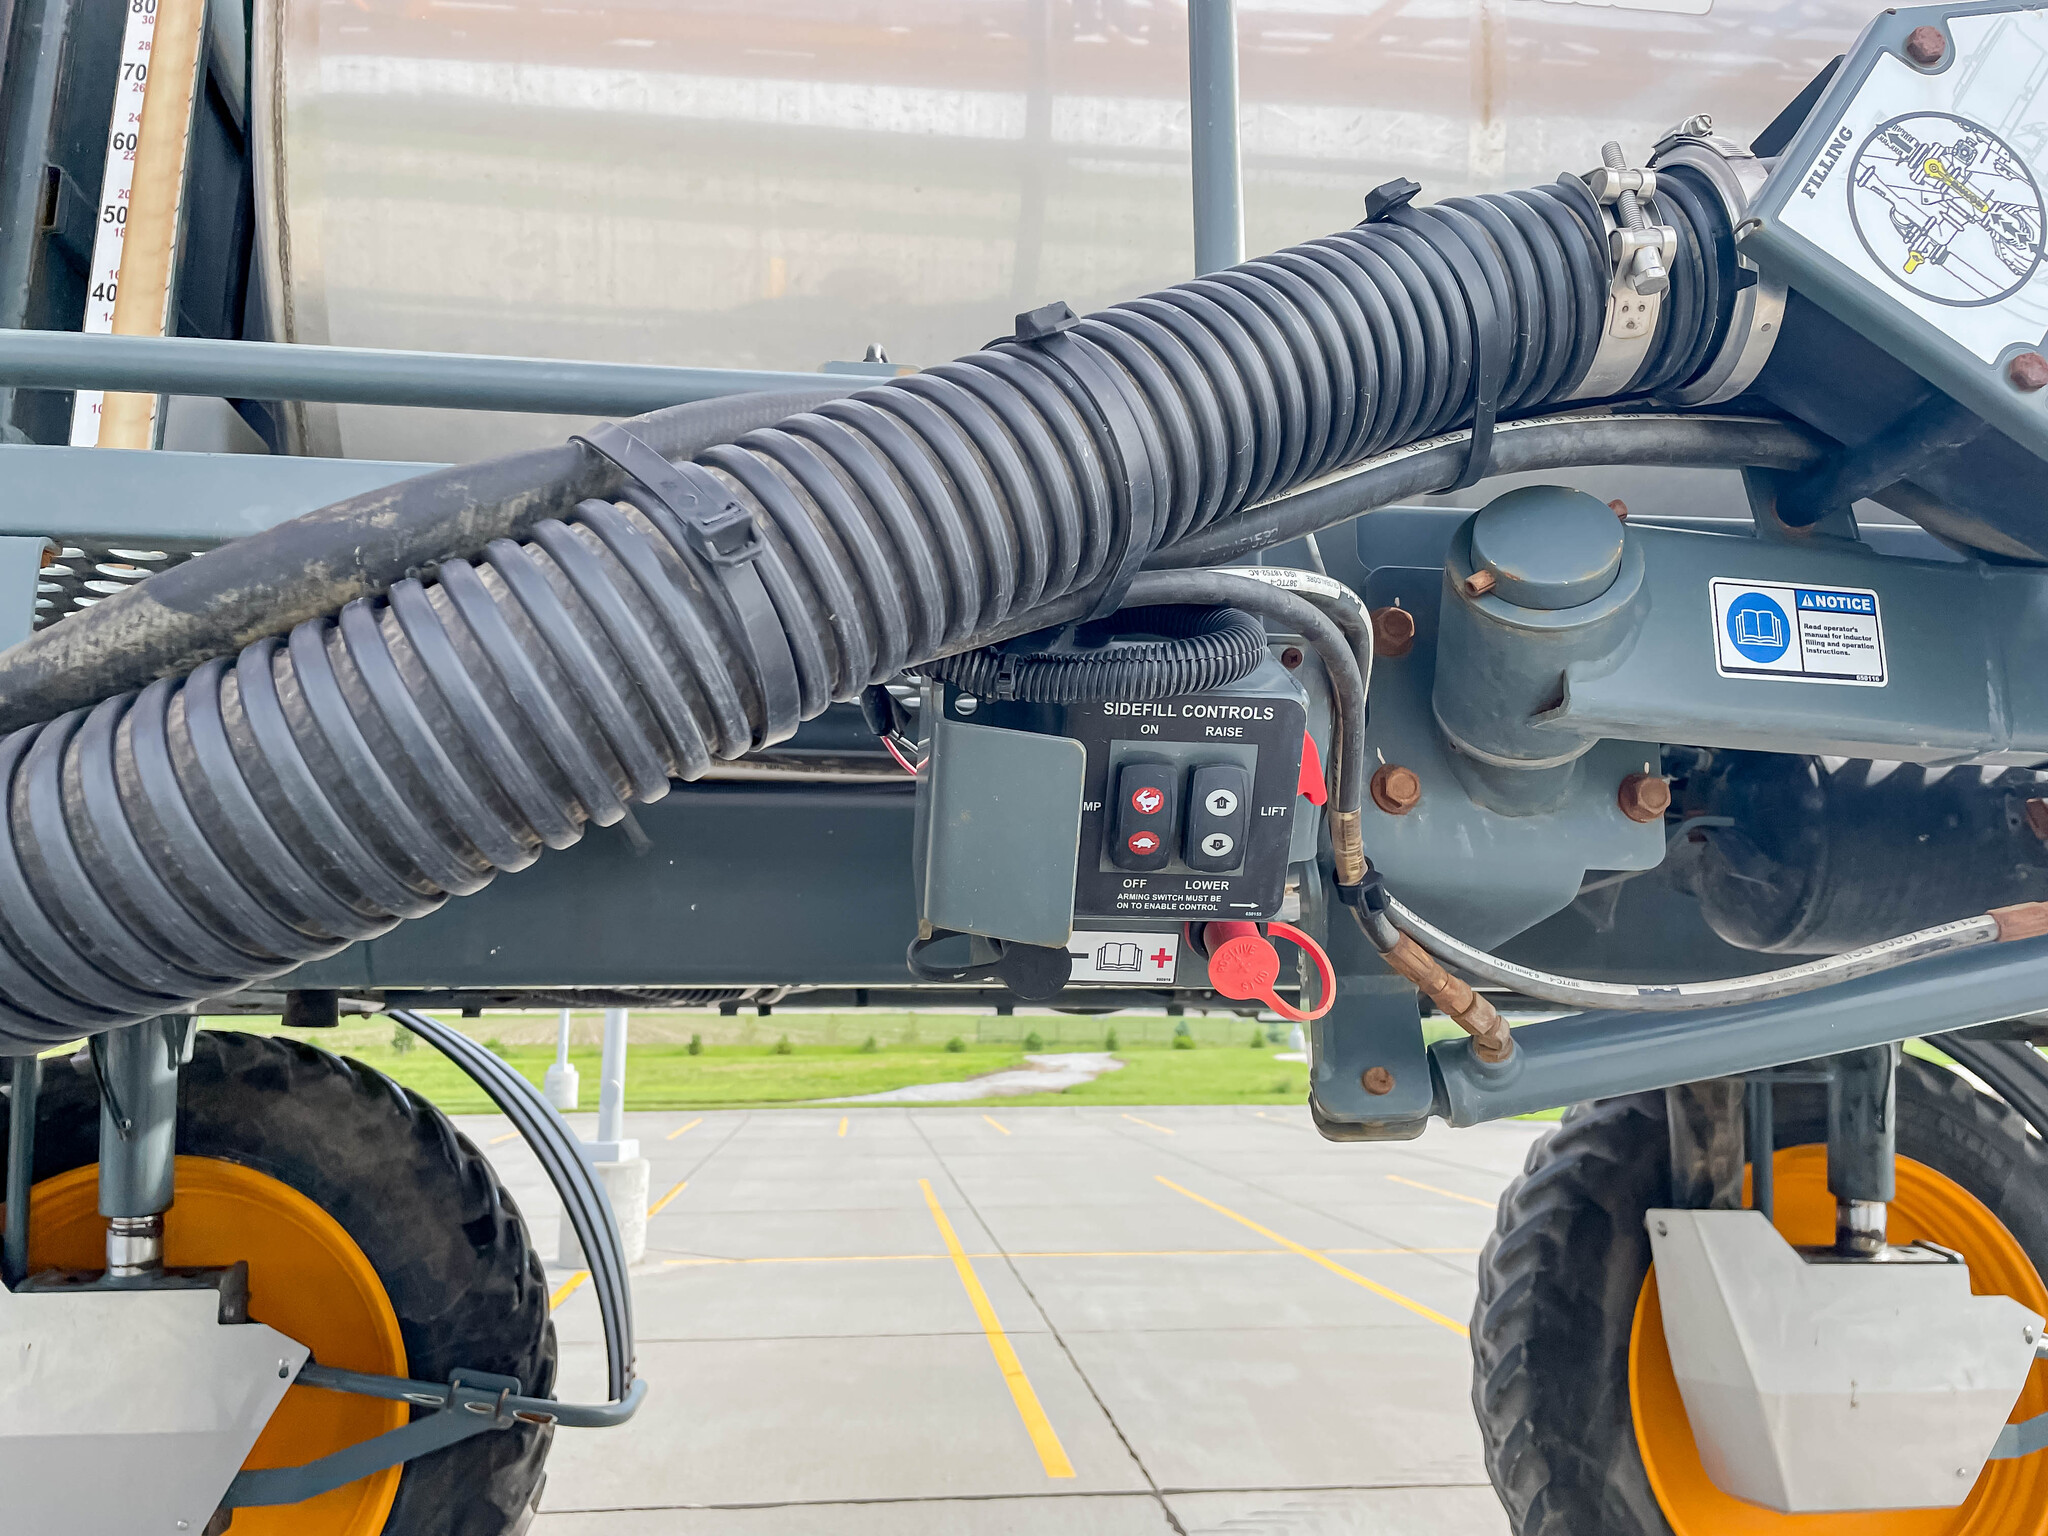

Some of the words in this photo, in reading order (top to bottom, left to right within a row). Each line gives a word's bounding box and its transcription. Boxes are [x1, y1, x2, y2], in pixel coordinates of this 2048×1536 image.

[132, 0, 156, 14] 80
[142, 16, 154, 24] 30
[138, 41, 151, 50] 28
[124, 63, 147, 81] 70
[132, 83, 145, 92] 26
[113, 132, 137, 150] 60
[1800, 126, 1854, 200] FILLING
[103, 205, 127, 224] 50
[92, 282, 117, 302] 40
[1815, 595, 1871, 610] NOTICE
[1806, 639, 1825, 647] filling
[1806, 647, 1850, 656] instructions.
[1103, 702, 1177, 717] SIDEFILL
[1182, 705, 1274, 720] CONTROLS
[1140, 724, 1159, 734] ON
[1205, 726, 1243, 737] RAISE
[1083, 802, 1102, 812] MP
[1260, 806, 1286, 817] LIFT
[1123, 879, 1147, 889] OFF
[1185, 880, 1229, 891] LOWER
[1117, 893, 1150, 901] ARMING
[1130, 902, 1142, 910] TO
[1144, 902, 1176, 910] ENABLE
[1179, 903, 1218, 911] CONTROL
[1217, 944, 1257, 973] POSITIVE
[1241, 970, 1269, 992] STUD
